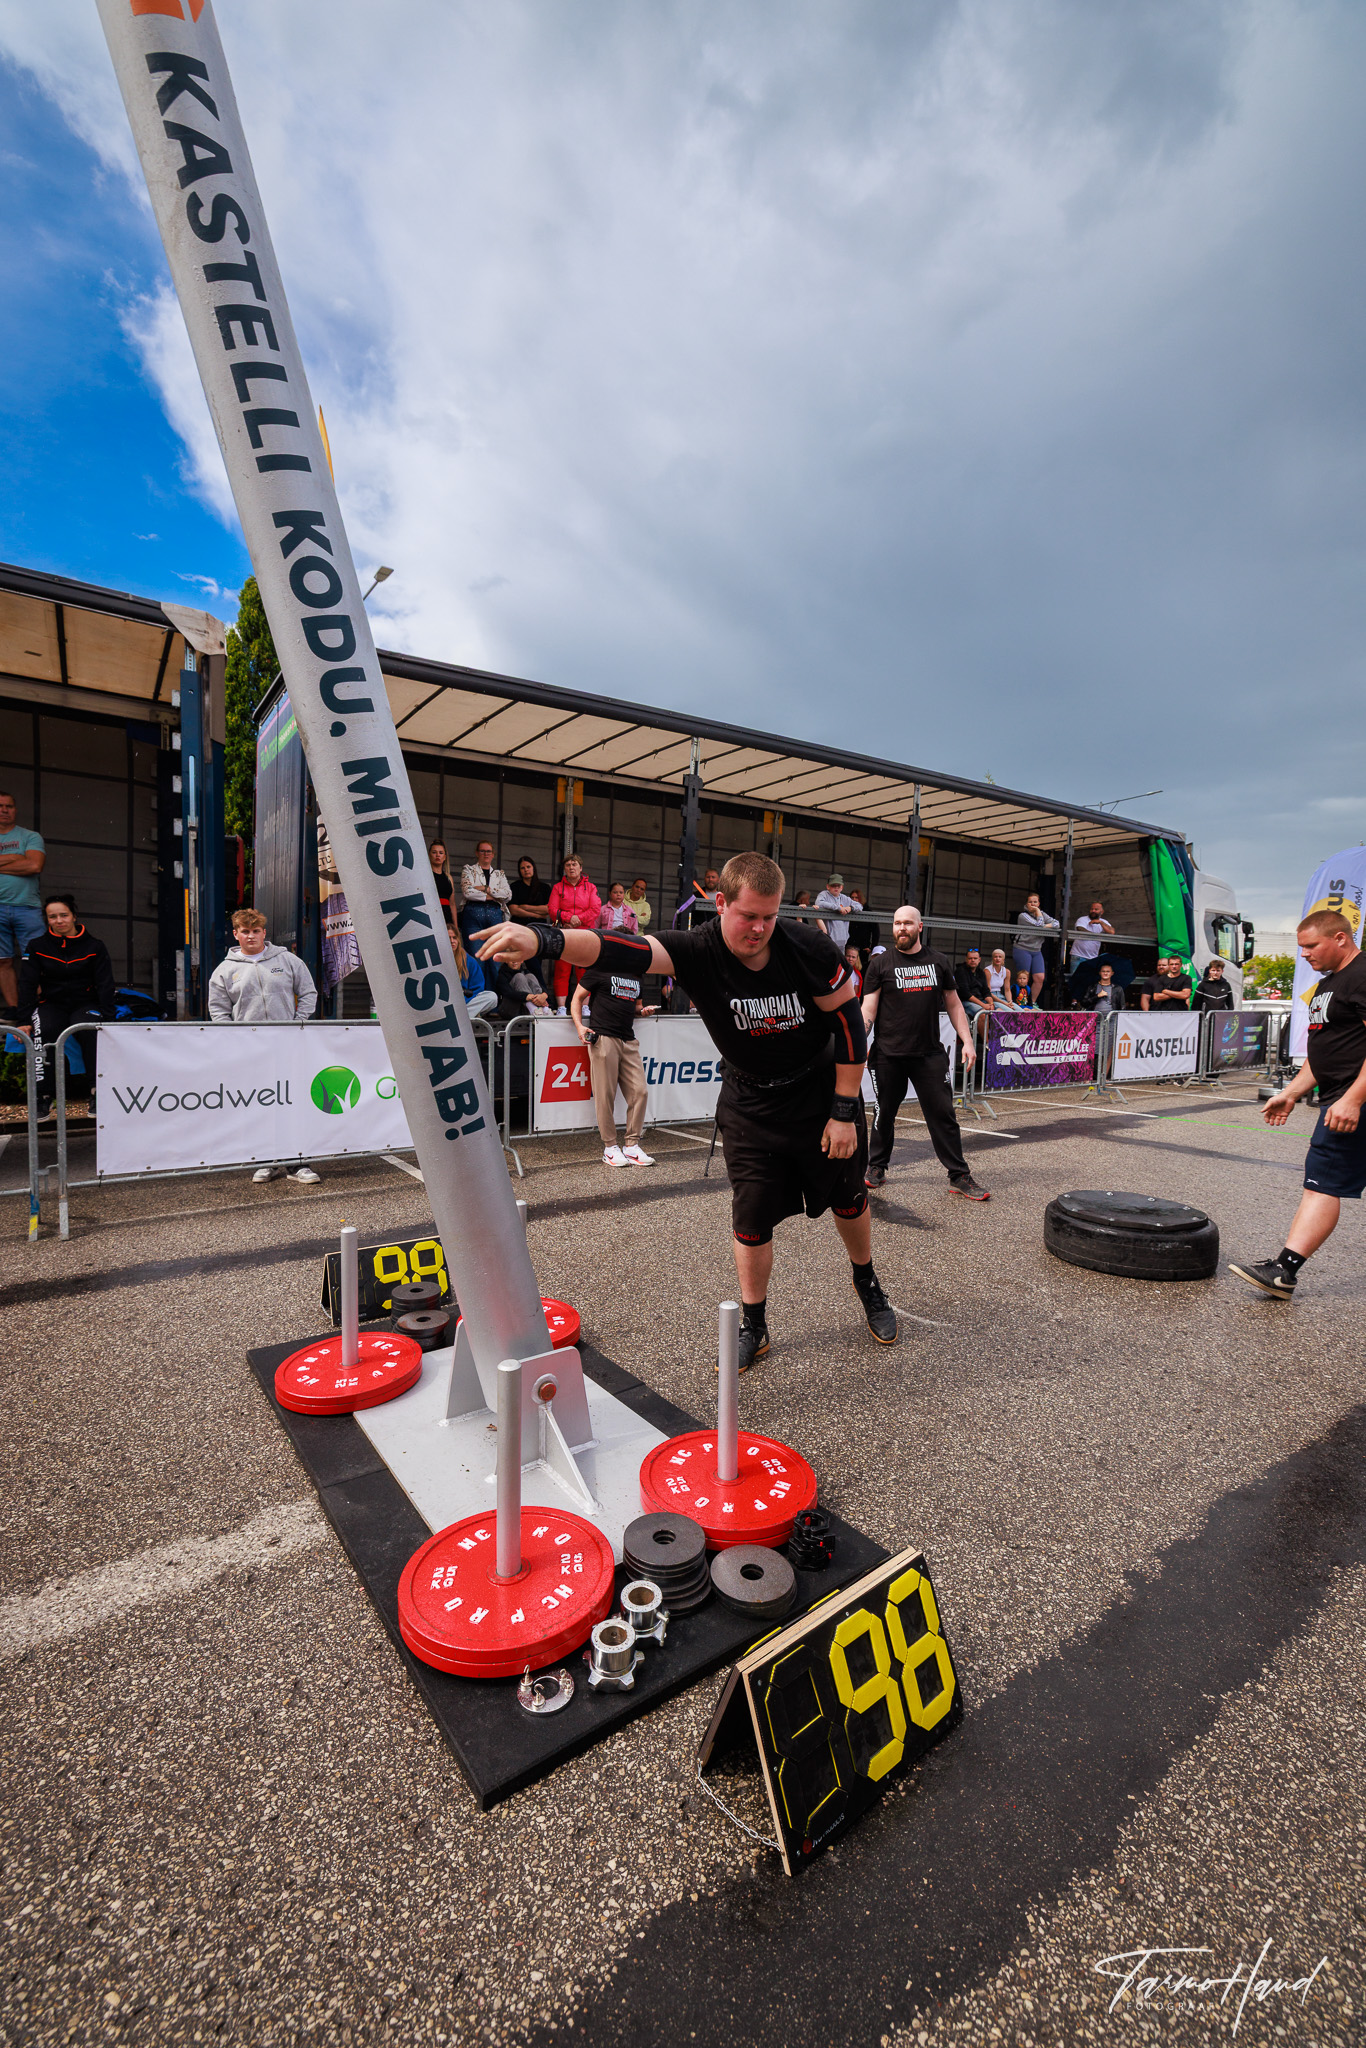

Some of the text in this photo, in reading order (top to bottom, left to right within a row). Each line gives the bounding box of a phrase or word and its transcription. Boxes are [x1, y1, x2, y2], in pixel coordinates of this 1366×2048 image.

[145, 51, 486, 1142] KASTELLI KODU. MIS KESTAB!
[1135, 1036, 1196, 1059] KASTELLI
[34, 1037, 45, 1082] ESONIA
[551, 1056, 723, 1089] 24 itness
[111, 1079, 293, 1114] Woodwell
[761, 1458, 782, 1468] 25
[768, 1465, 788, 1475] KG
[665, 1476, 687, 1487] 25
[670, 1485, 691, 1495] KG
[560, 1552, 584, 1564] 25
[432, 1565, 459, 1578] 25
[560, 1564, 583, 1575] KG
[430, 1577, 455, 1590] KG
[829, 1567, 956, 1783] 98
